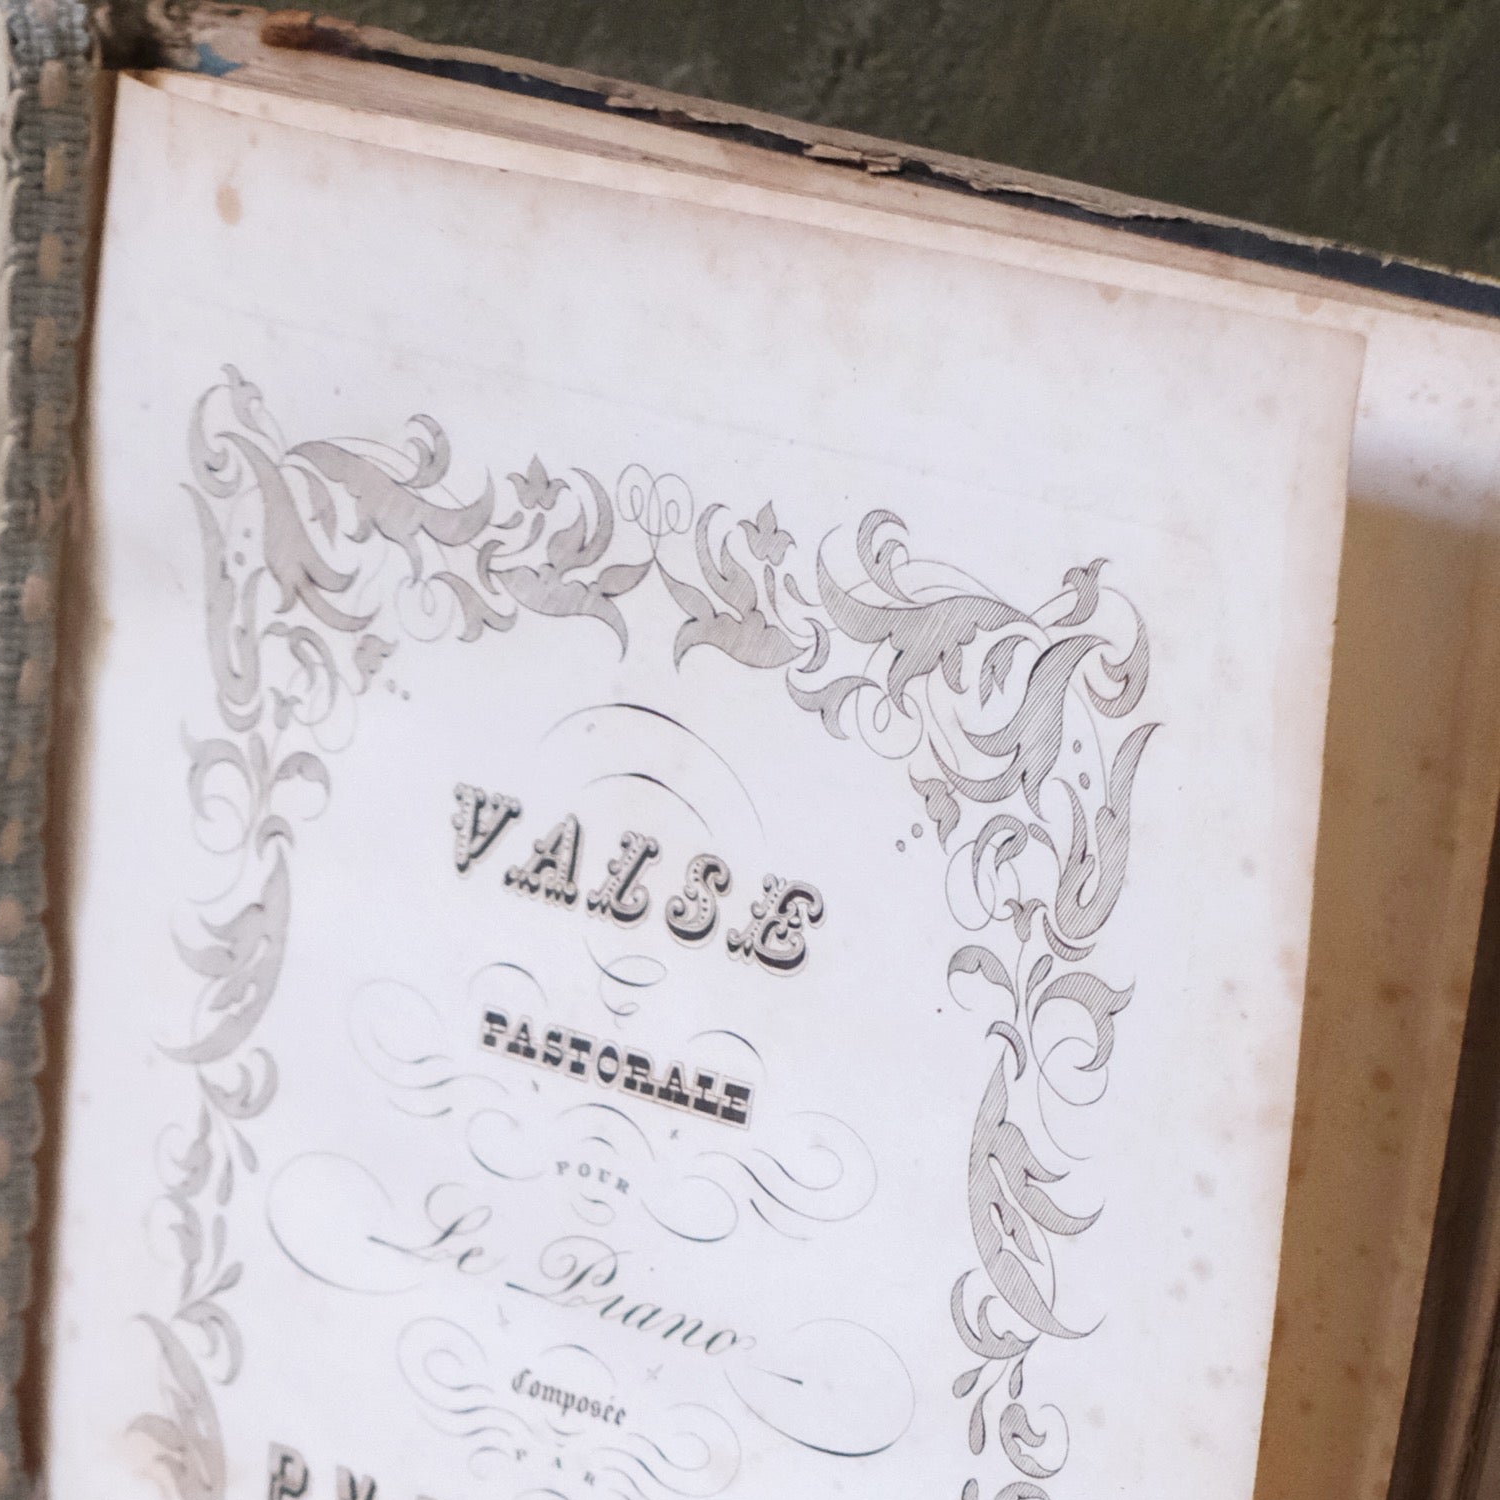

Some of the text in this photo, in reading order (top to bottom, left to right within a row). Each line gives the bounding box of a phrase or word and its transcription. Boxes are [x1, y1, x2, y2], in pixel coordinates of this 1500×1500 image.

[452, 782, 827, 977] VALSE
[479, 1005, 757, 1130] PASTORALE
[555, 1159, 631, 1196] POUR
[368, 1182, 756, 1356] Le Piano
[511, 1368, 627, 1427] Composée
